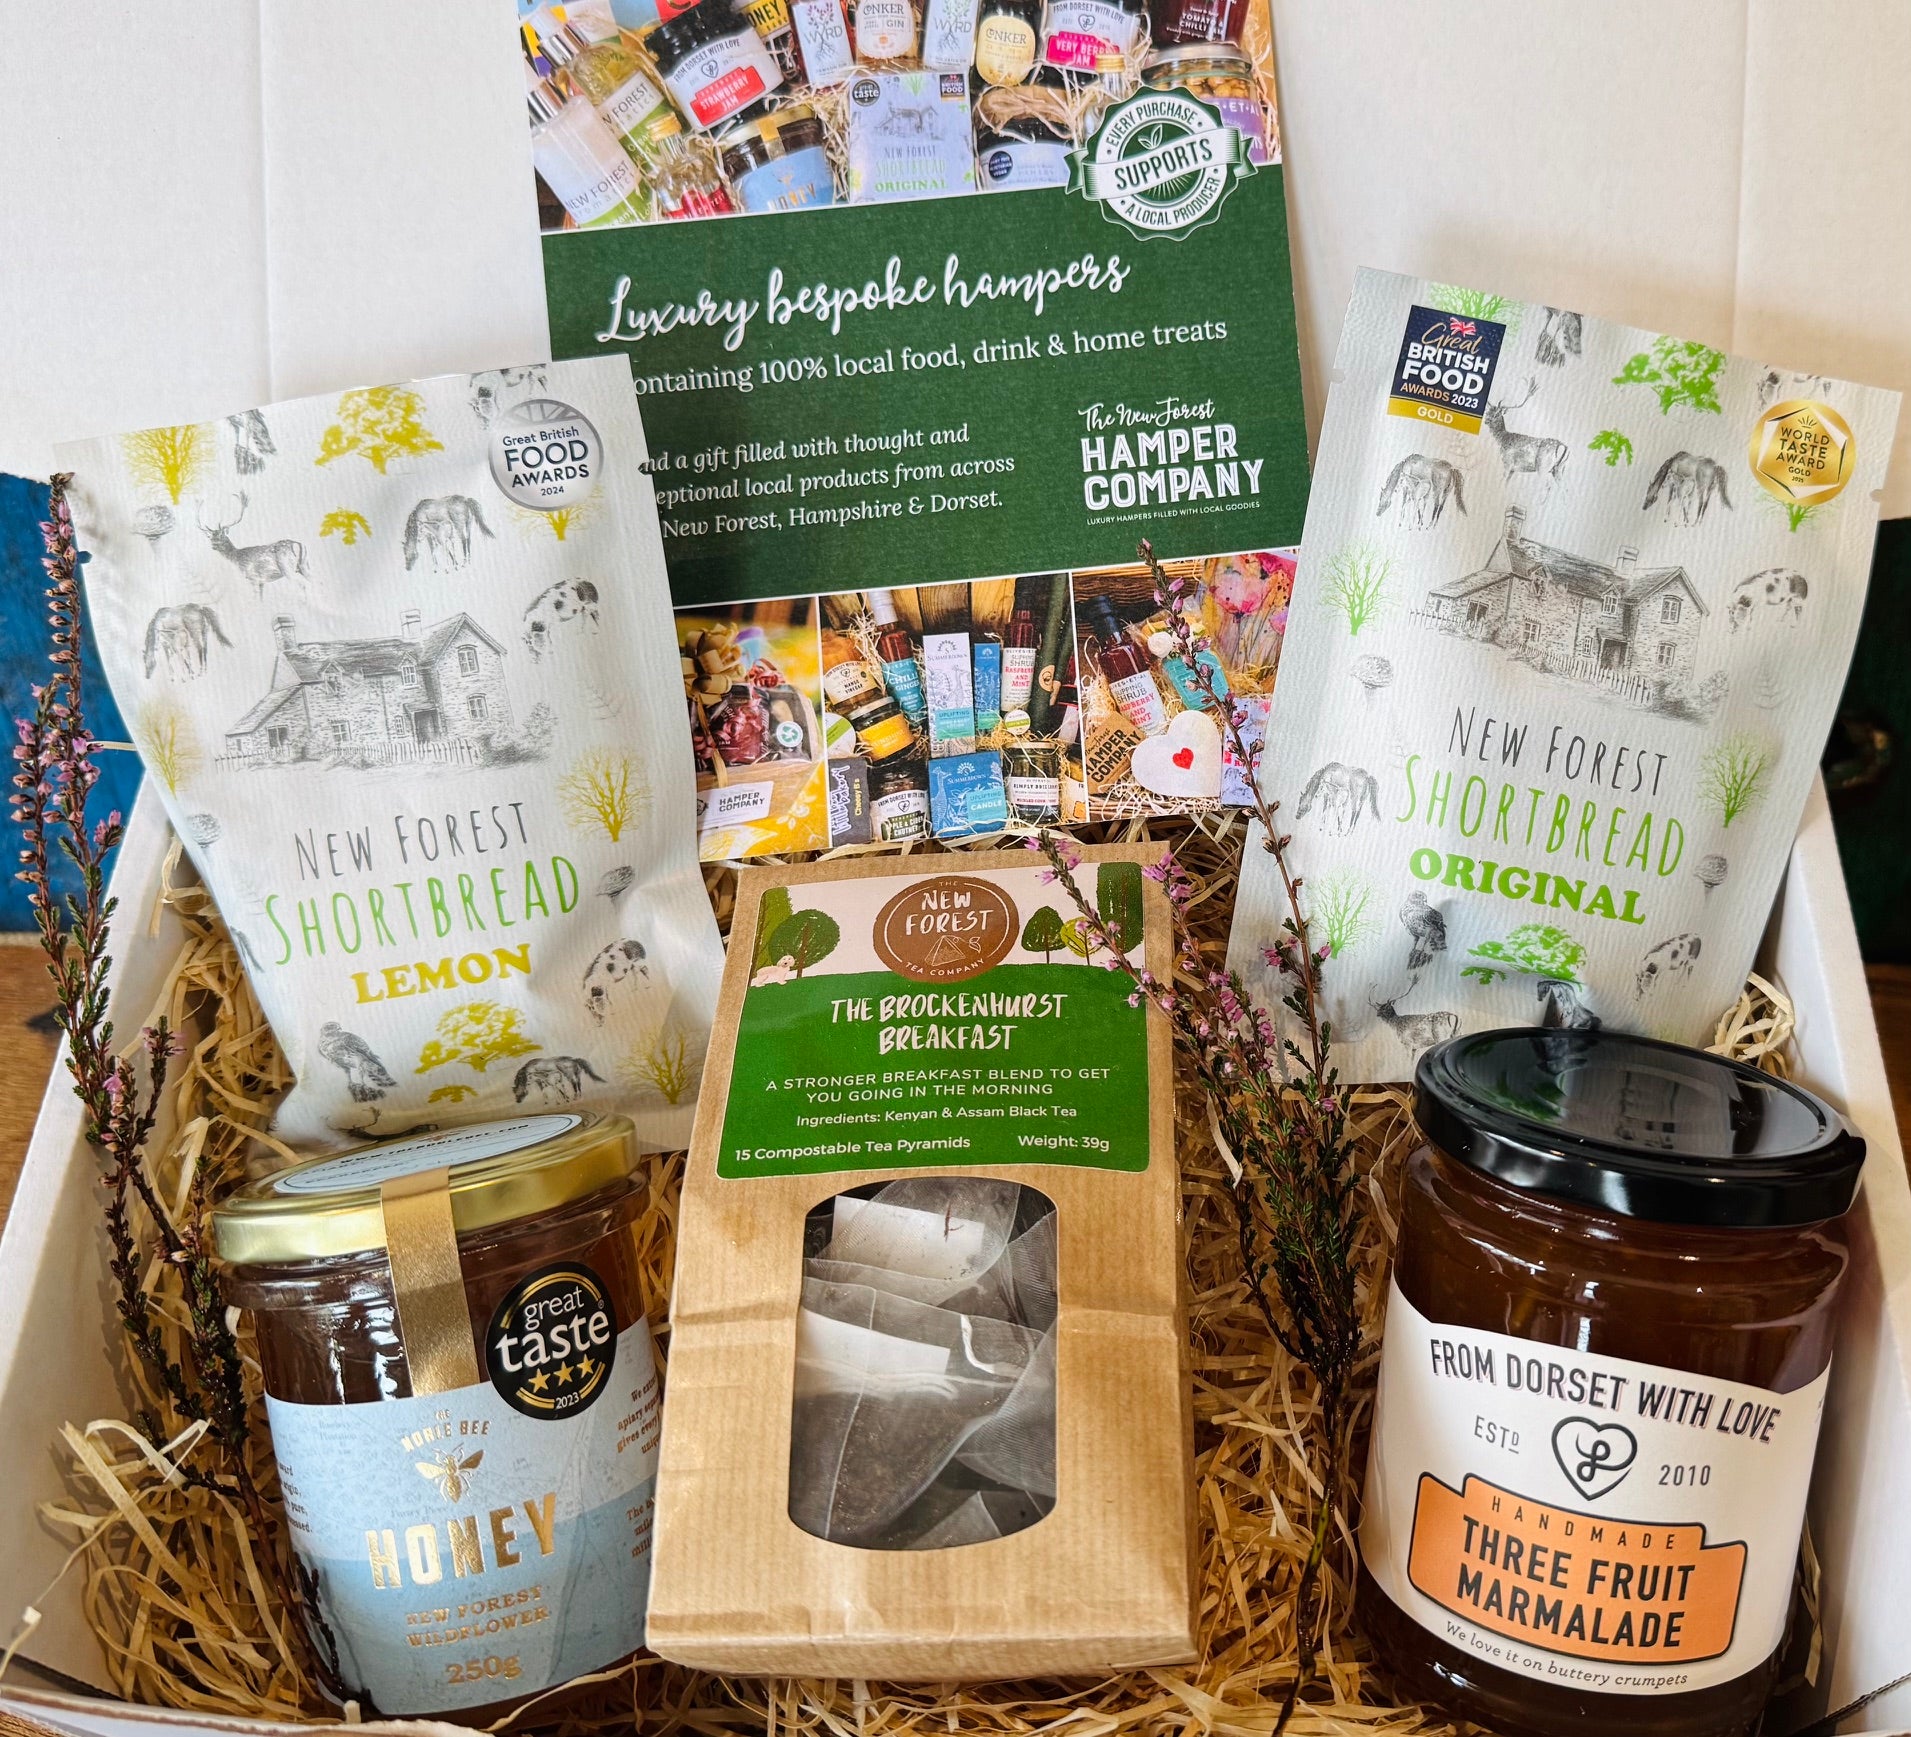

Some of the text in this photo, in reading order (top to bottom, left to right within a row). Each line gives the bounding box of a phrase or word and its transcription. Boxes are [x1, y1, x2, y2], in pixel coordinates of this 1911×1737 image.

[1069, 2, 1093, 12] DORSET
[804, 25, 843, 45] WYRD
[886, 19, 905, 29] GIN
[934, 17, 972, 34] WYRD
[1056, 39, 1078, 53] VERY
[613, 82, 649, 117] FOREST
[700, 74, 750, 111] STRAWBERRY
[722, 96, 739, 112] JAM
[854, 89, 879, 98] taste
[1106, 101, 1198, 147] EVERY PURCHASE
[1114, 138, 1213, 191] SUPPORTS
[875, 179, 947, 192] ORIGINAL
[1124, 176, 1220, 226] A LOCAL PRODUCER
[594, 253, 1130, 352] Luxury bespoke hampers
[1422, 322, 1483, 354] Great
[634, 320, 1228, 393] ontaining 100% local food, drink & home treats
[1408, 342, 1490, 374] BRITISH
[1402, 359, 1484, 395] FOOD
[1400, 382, 1479, 409] AWARDS 2023
[1078, 396, 1215, 432] The New Forest
[1417, 406, 1454, 424] GOLD
[502, 426, 580, 447] Great British
[640, 423, 970, 473] nd a gift filled with thought and
[1080, 423, 1239, 473] HAMPER
[1780, 438, 1828, 459] TASTE
[1781, 427, 1830, 446] WORLD
[504, 439, 589, 472] FOOD
[1776, 452, 1825, 470] AWARD
[1788, 466, 1811, 477] GOLD
[511, 464, 590, 488] AWARDS
[541, 485, 565, 496] 2024
[656, 457, 1015, 509] eptional local products from across
[1084, 458, 1264, 511] COMPANY
[662, 490, 1004, 538] New Forest, Hampshire & Dorset.
[1087, 501, 1260, 526] LUXURY HAMPERS FILLED WITH LOCAL GOODIES
[1091, 730, 1141, 783] COMPANY
[1448, 706, 1668, 796] NEW FOREST
[719, 792, 760, 806] HAMPER
[719, 798, 765, 813] COMPANY
[1396, 753, 1684, 877] SHORTBREAD
[294, 802, 528, 881] NEW FOREST
[921, 889, 971, 911] NEW
[1409, 848, 1646, 925] ORIGINAL
[266, 855, 579, 966] SHORTBREAD
[905, 909, 994, 936] FOREST
[350, 942, 533, 1005] LEMON
[906, 958, 985, 976] TEA COMPANY
[830, 991, 1068, 1024] THE BROCKENHURST
[878, 1023, 1018, 1056] BREAKFAST
[766, 1068, 1110, 1091] A STRONGER BREAKFAST BLEND TO GET
[806, 1084, 1053, 1104] YOU GOING IN THE MORNING
[796, 1105, 1077, 1128] Ingredients: Kenyan & Assam Black Tea
[735, 1136, 971, 1161] 15 Compostable Tea Pyramids
[1018, 1135, 1110, 1152] Weight: 39g
[525, 1286, 584, 1331] great
[495, 1310, 610, 1373] taste
[555, 1391, 580, 1409] 2023
[1430, 1339, 1781, 1444] FROM DORSET WITH LOVE
[460, 1420, 491, 1435] BEE
[1658, 1464, 1711, 1487] 2010
[1491, 1495, 1676, 1550] HANDMADE
[365, 1491, 557, 1590] HONEY
[1463, 1514, 1696, 1602] THREE FRUIT
[406, 1585, 543, 1626] NEW FOREST
[1456, 1562, 1686, 1648] MARMALADE
[406, 1605, 550, 1647] WILDFLOWER
[445, 1655, 522, 1685] 250g
[1446, 1620, 1689, 1690] We love it on buttery crumpets
